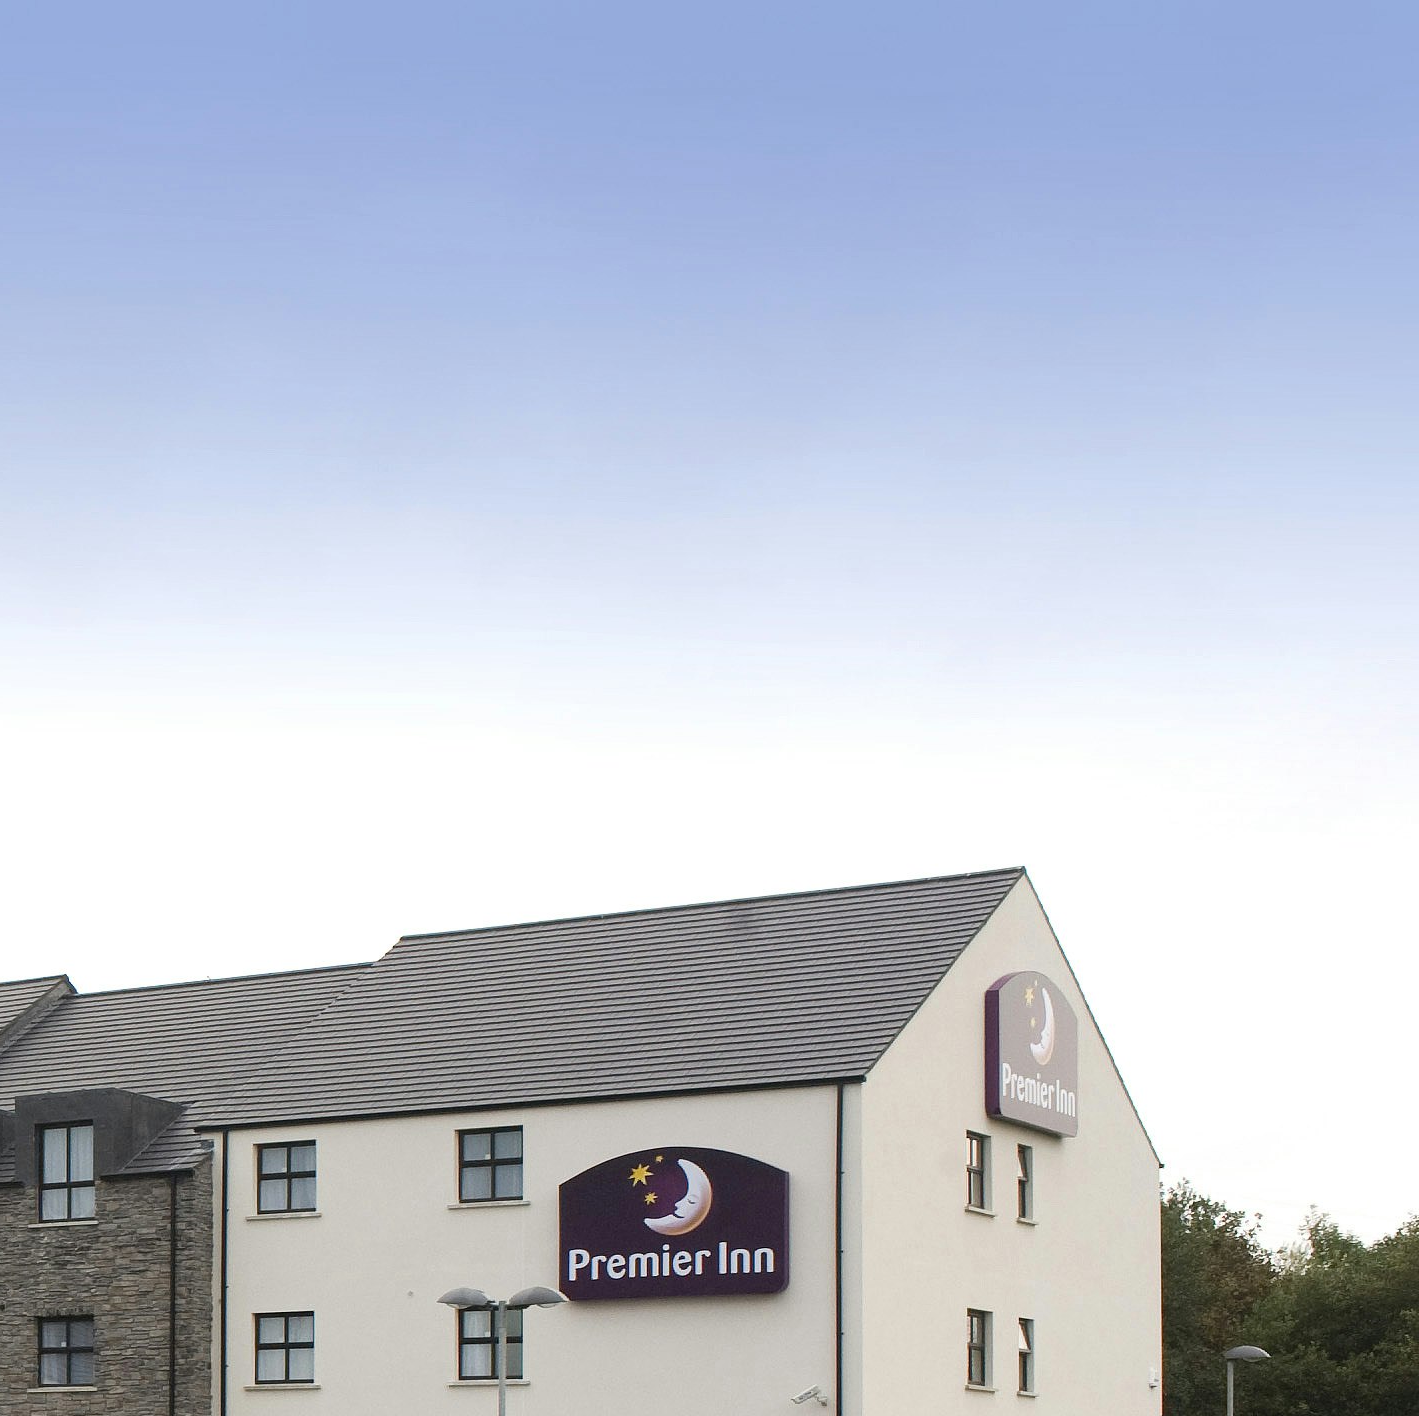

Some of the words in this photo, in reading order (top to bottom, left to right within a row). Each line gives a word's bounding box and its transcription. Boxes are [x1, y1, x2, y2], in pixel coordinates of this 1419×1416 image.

[1002, 1062, 1054, 1110] Premier
[1056, 1079, 1076, 1117] Inn
[568, 1244, 711, 1281] Premier
[718, 1241, 774, 1275] Inn
